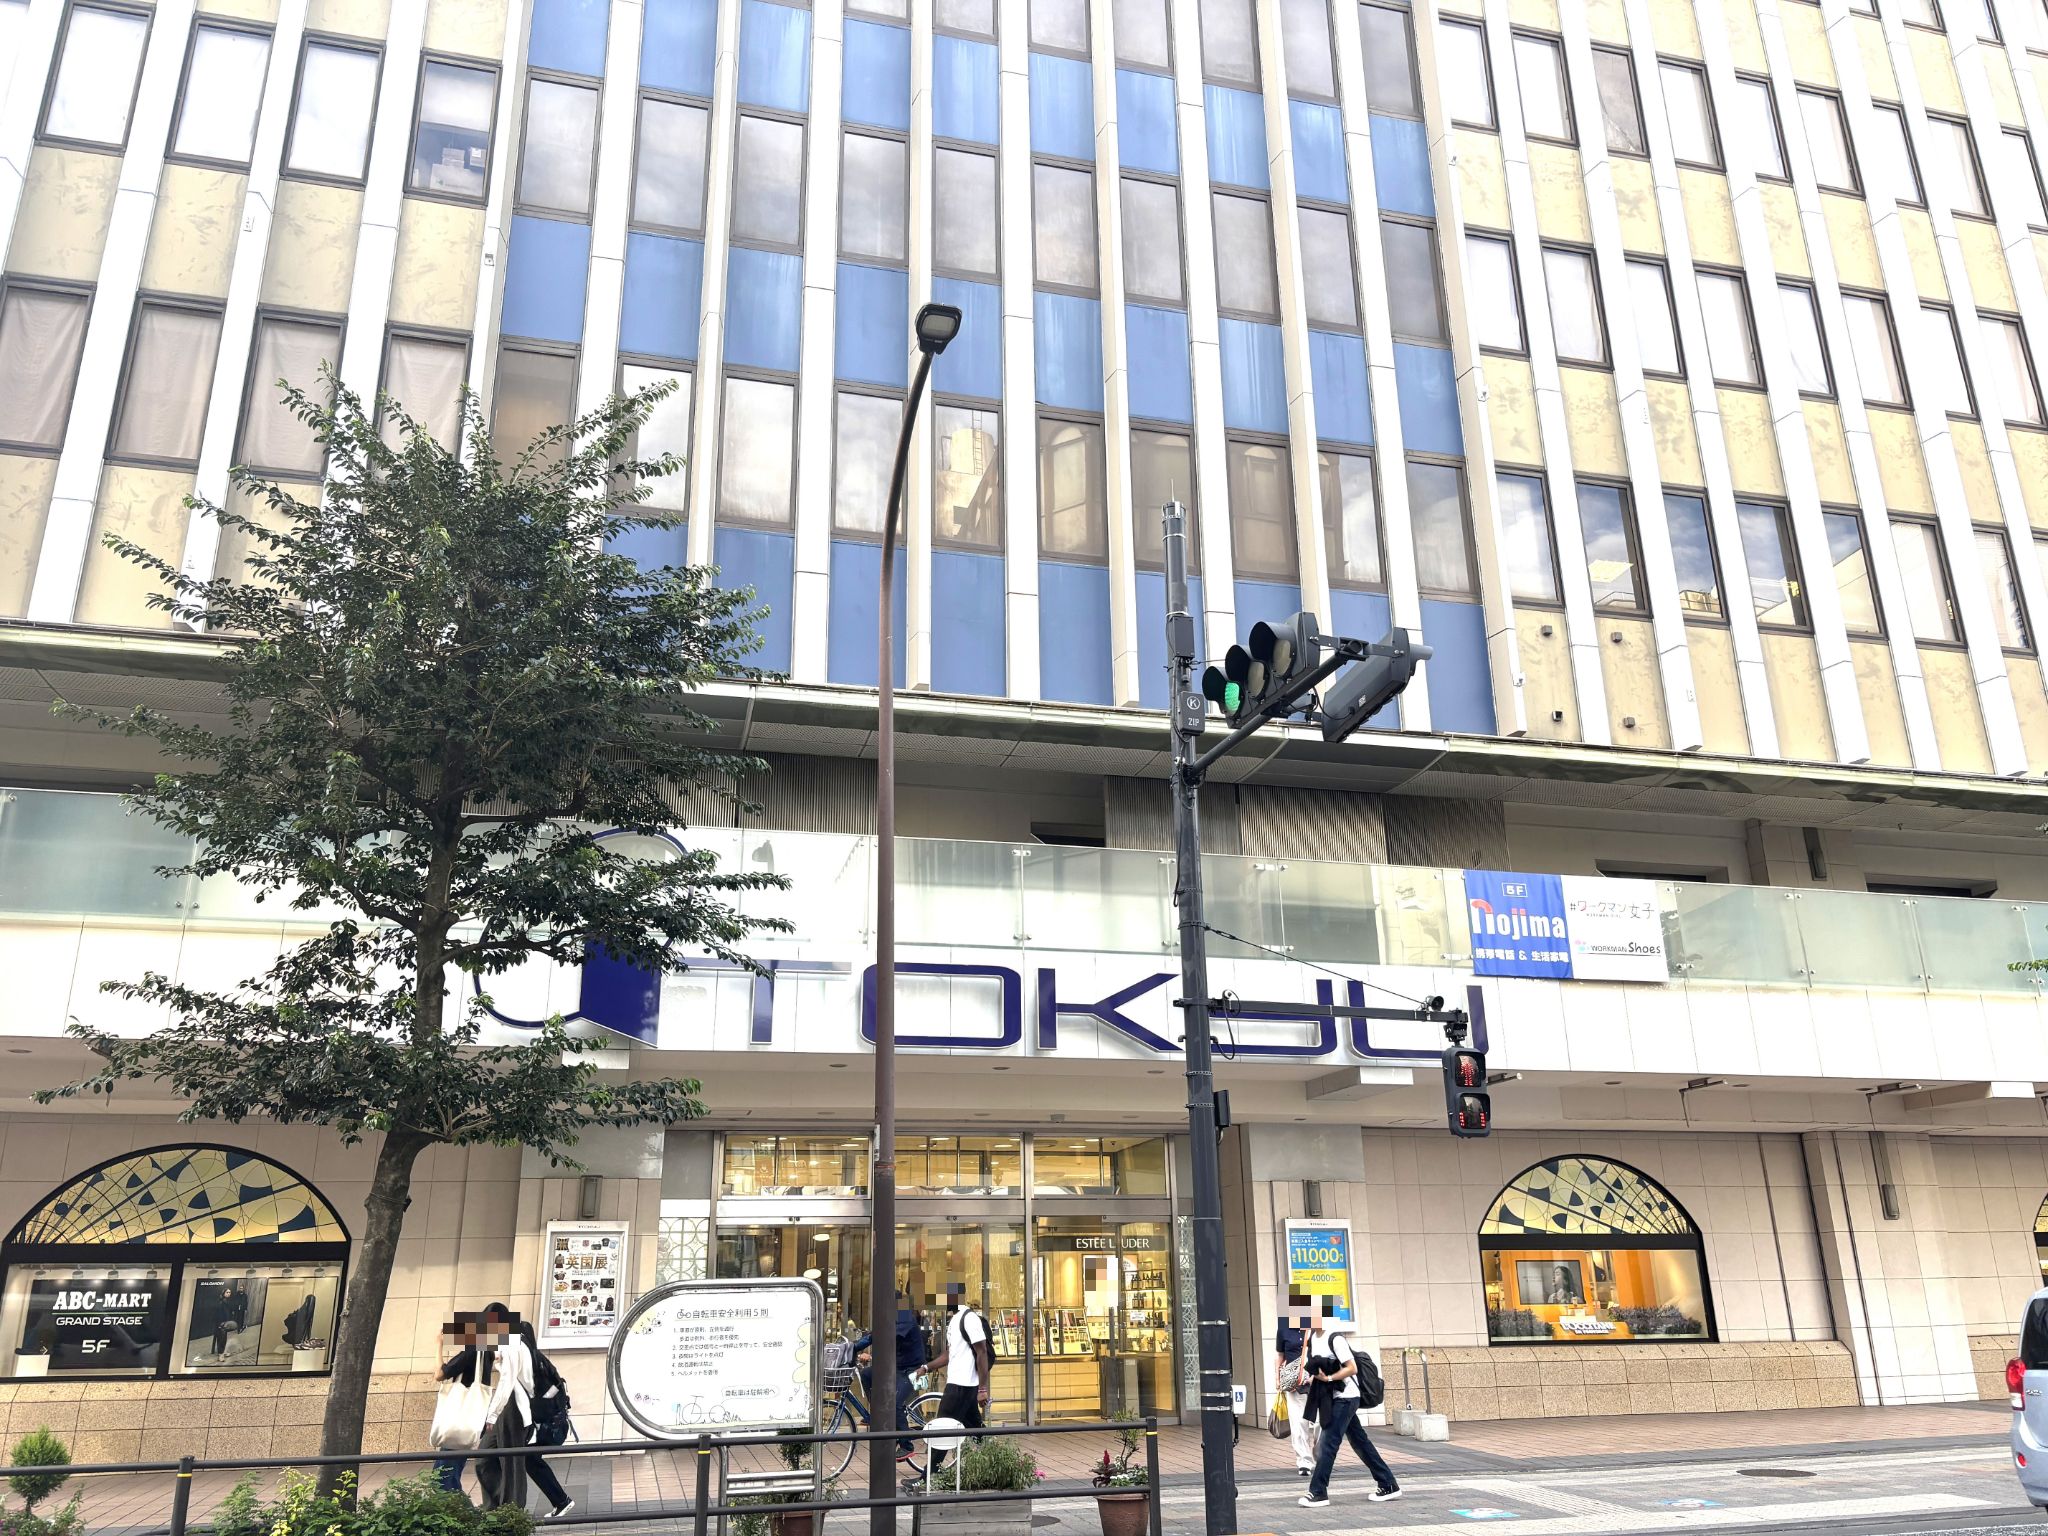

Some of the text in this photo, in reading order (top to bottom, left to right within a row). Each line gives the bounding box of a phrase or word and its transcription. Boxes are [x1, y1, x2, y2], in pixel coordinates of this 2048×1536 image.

[1188, 718, 1200, 726] ZIP
[1506, 885, 1525, 896] 5F
[1470, 898, 1566, 940] nojima
[1590, 942, 1661, 954] WORKMAN Shoes
[1109, 1238, 1150, 1249] LUDER
[566, 1256, 608, 1270] 英国展
[52, 1291, 152, 1311] ABC-MART
[56, 1316, 143, 1326] GRAND STAGE
[82, 1340, 110, 1354] 5F
